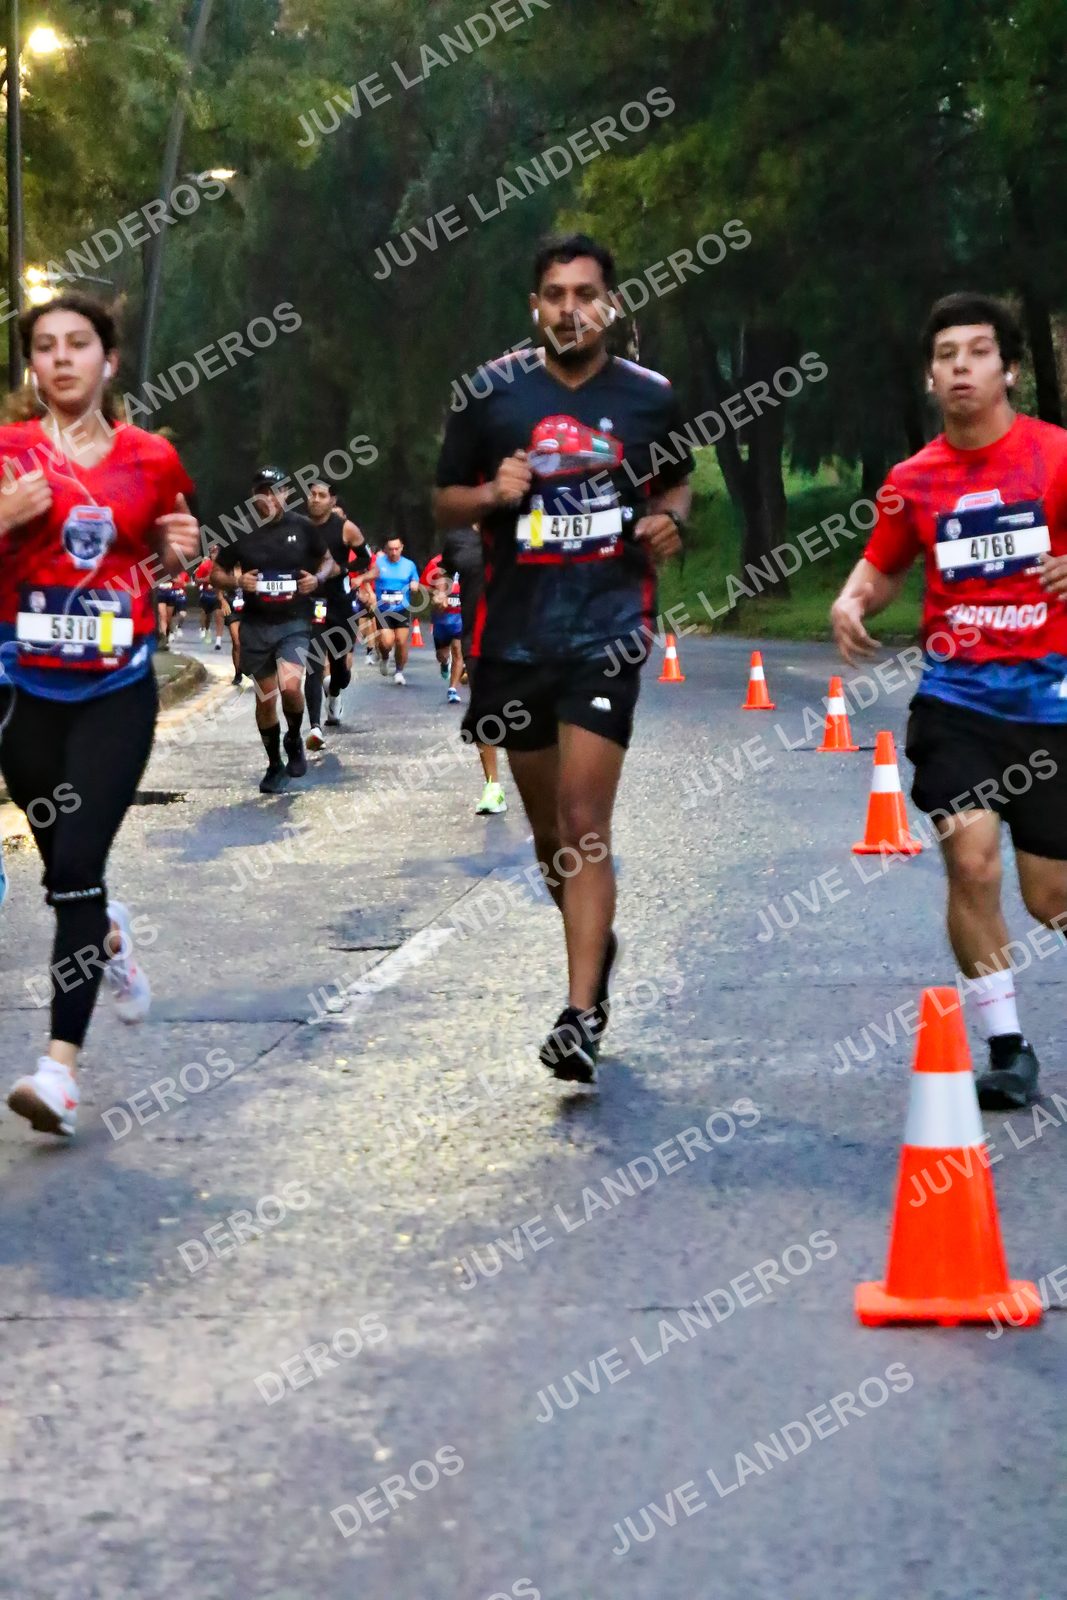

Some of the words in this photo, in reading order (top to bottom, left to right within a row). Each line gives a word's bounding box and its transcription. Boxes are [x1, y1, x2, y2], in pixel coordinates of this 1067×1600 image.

[551, 516, 592, 538] 4767
[970, 534, 1014, 560] 4768
[52, 617, 96, 640] 5310
